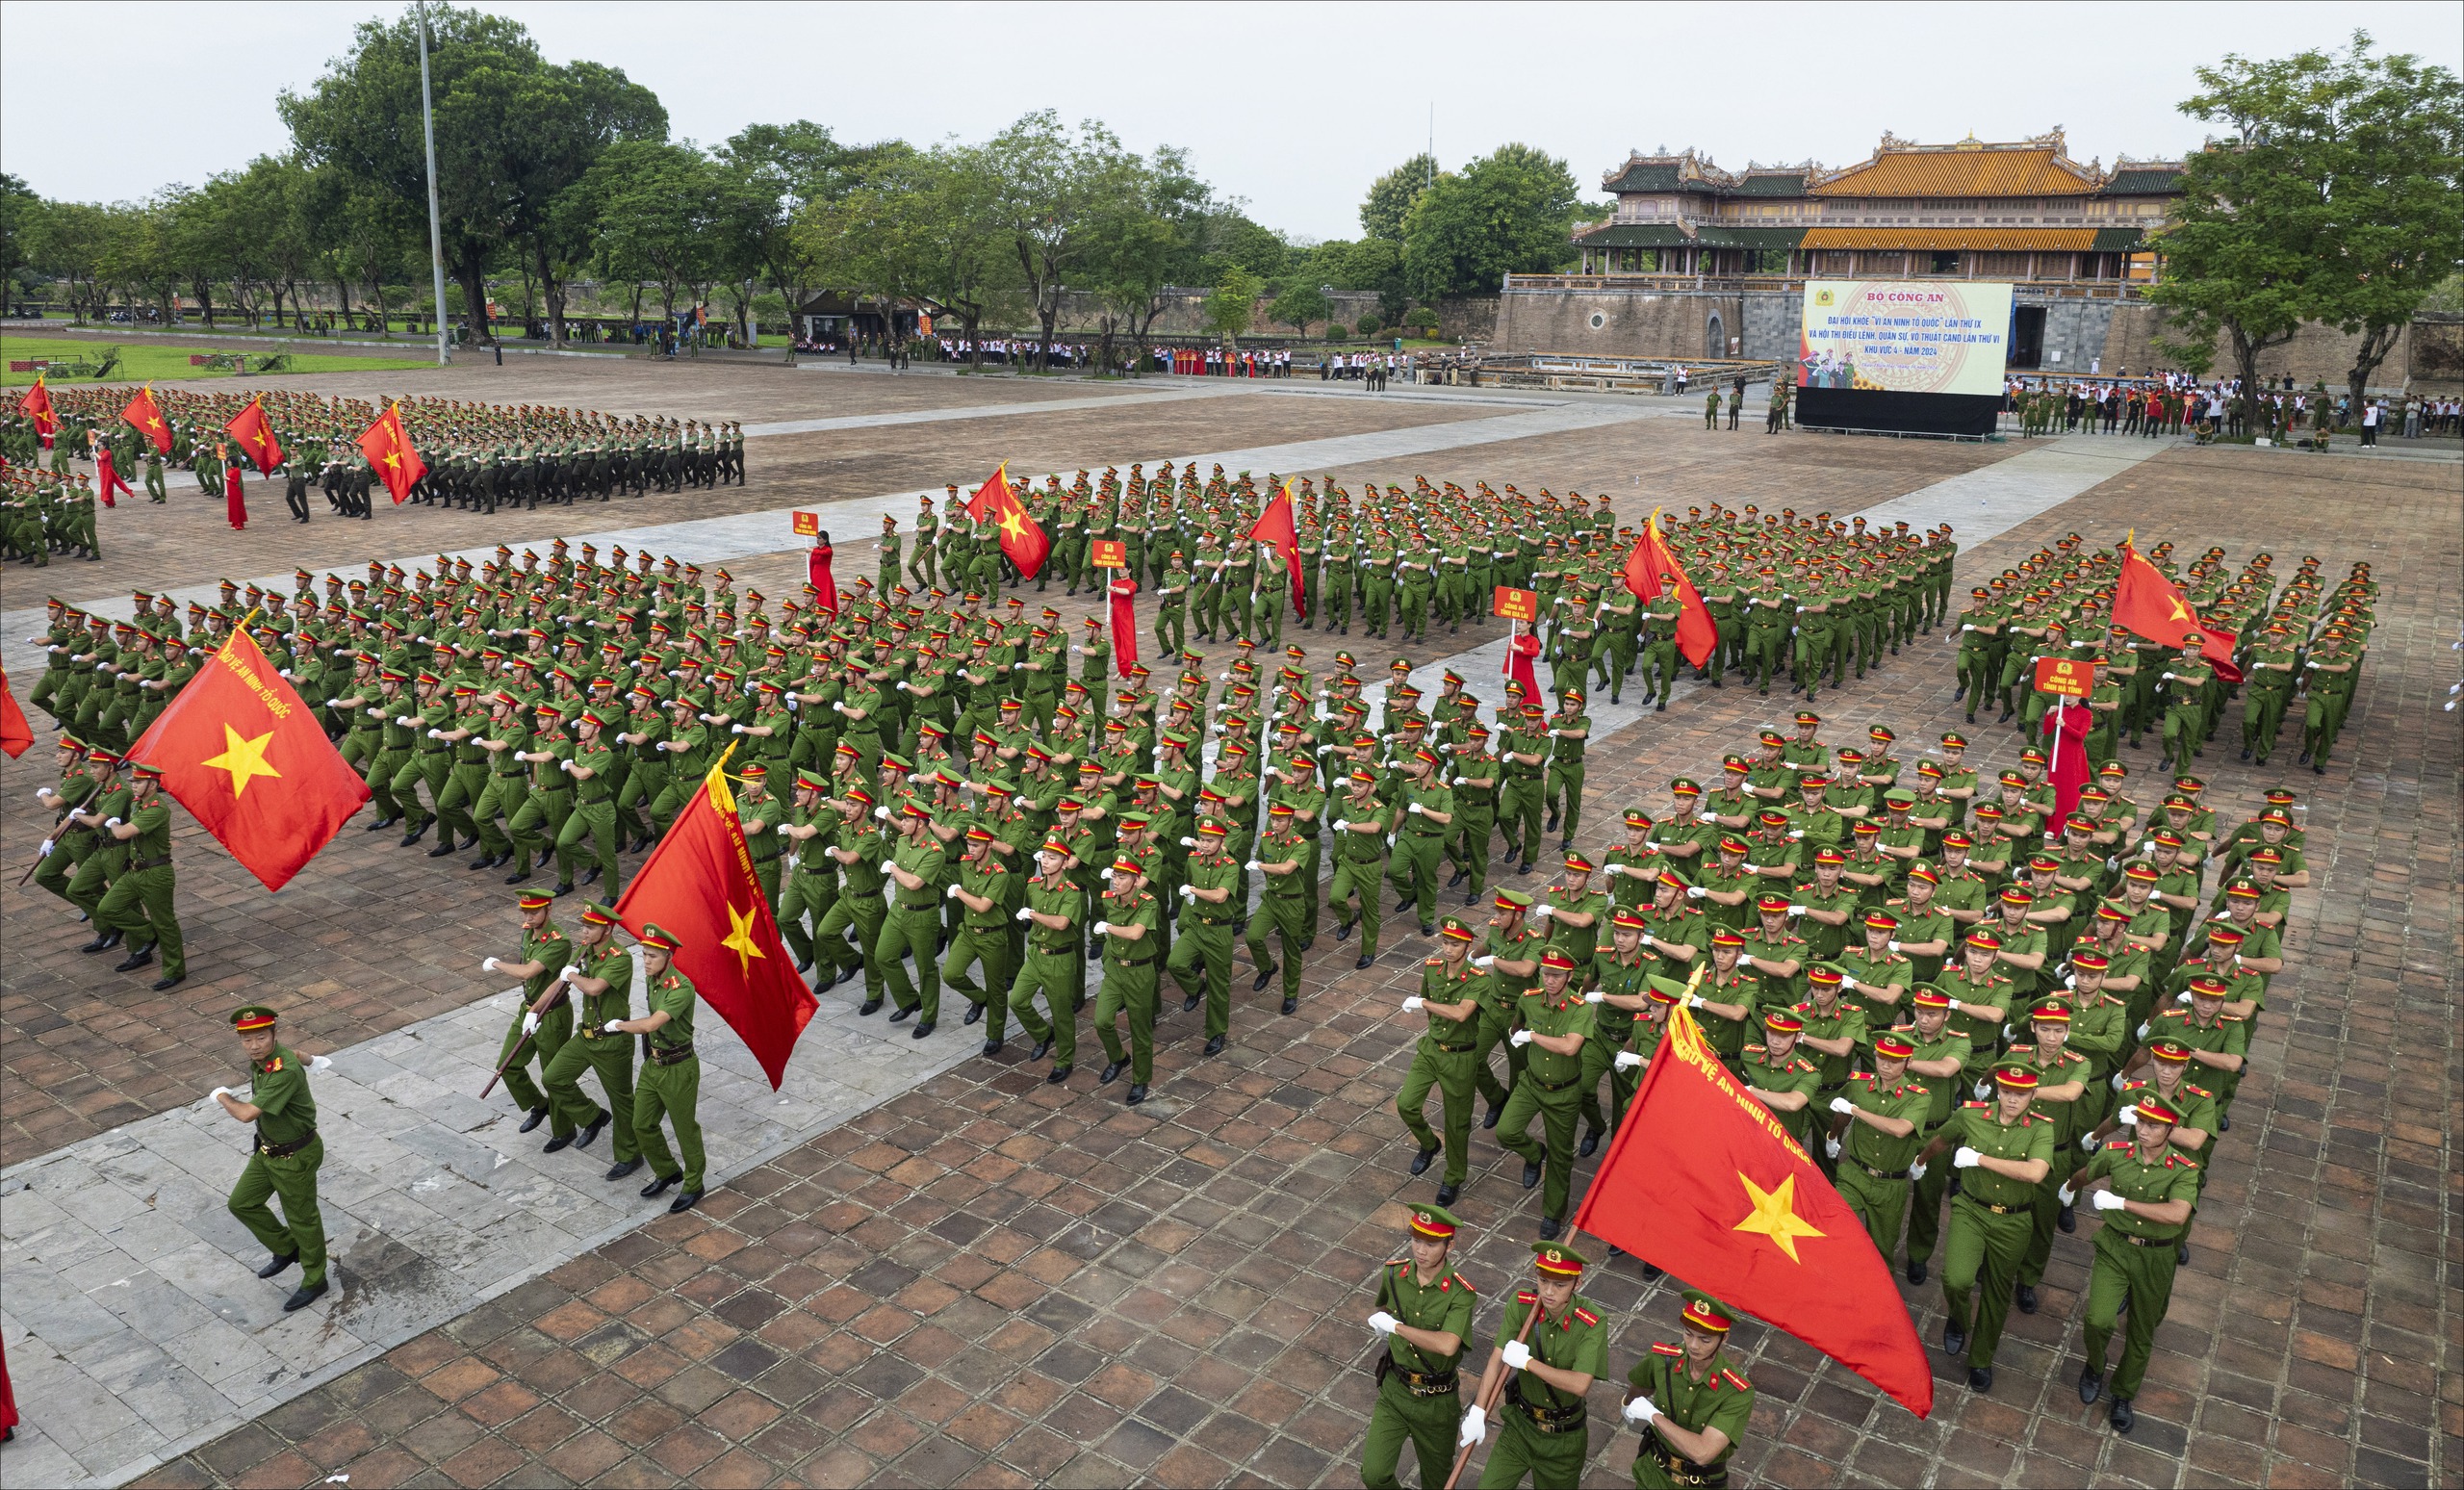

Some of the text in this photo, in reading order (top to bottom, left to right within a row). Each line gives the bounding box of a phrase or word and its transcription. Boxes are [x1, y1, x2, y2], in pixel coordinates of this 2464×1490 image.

[1867, 291, 1944, 303] BỘ CÔNG AN
[1828, 316, 1838, 326] ĐẠI
[1840, 315, 1851, 327] HỘI
[1893, 318, 1911, 326] NINH
[1912, 316, 1920, 327] TỔ
[1944, 316, 1958, 327] LẦN
[1960, 318, 1974, 328] THỨ
[1974, 320, 1982, 328] IX
[1809, 329, 1817, 338] VÀ
[1818, 329, 1829, 340] HỘI
[1831, 330, 1840, 339] THI
[1879, 331, 1897, 341] QUÂN
[1921, 332, 1942, 344] THUẬT
[1943, 333, 1962, 342] CAND
[1964, 332, 1977, 343] LẦN
[1978, 333, 1992, 344] THỨ
[1992, 335, 2000, 344] VI
[1880, 346, 1892, 355] VỰC
[1904, 346, 1920, 355] NĂM
[1921, 347, 1938, 355] 2024
[228, 657, 244, 672] VỆ
[235, 665, 252, 679] AN
[244, 673, 265, 692] NINH
[2050, 676, 2066, 684] CÔNG
[258, 688, 278, 702] TỔ
[2043, 681, 2057, 691] TỈNH
[2067, 686, 2082, 695] TĨNH
[267, 697, 293, 719] QUỐC
[1700, 1058, 1719, 1082] VỆ
[1716, 1076, 1734, 1097] AN
[1735, 1093, 1767, 1124] NINH
[1767, 1118, 1784, 1140] TỔ
